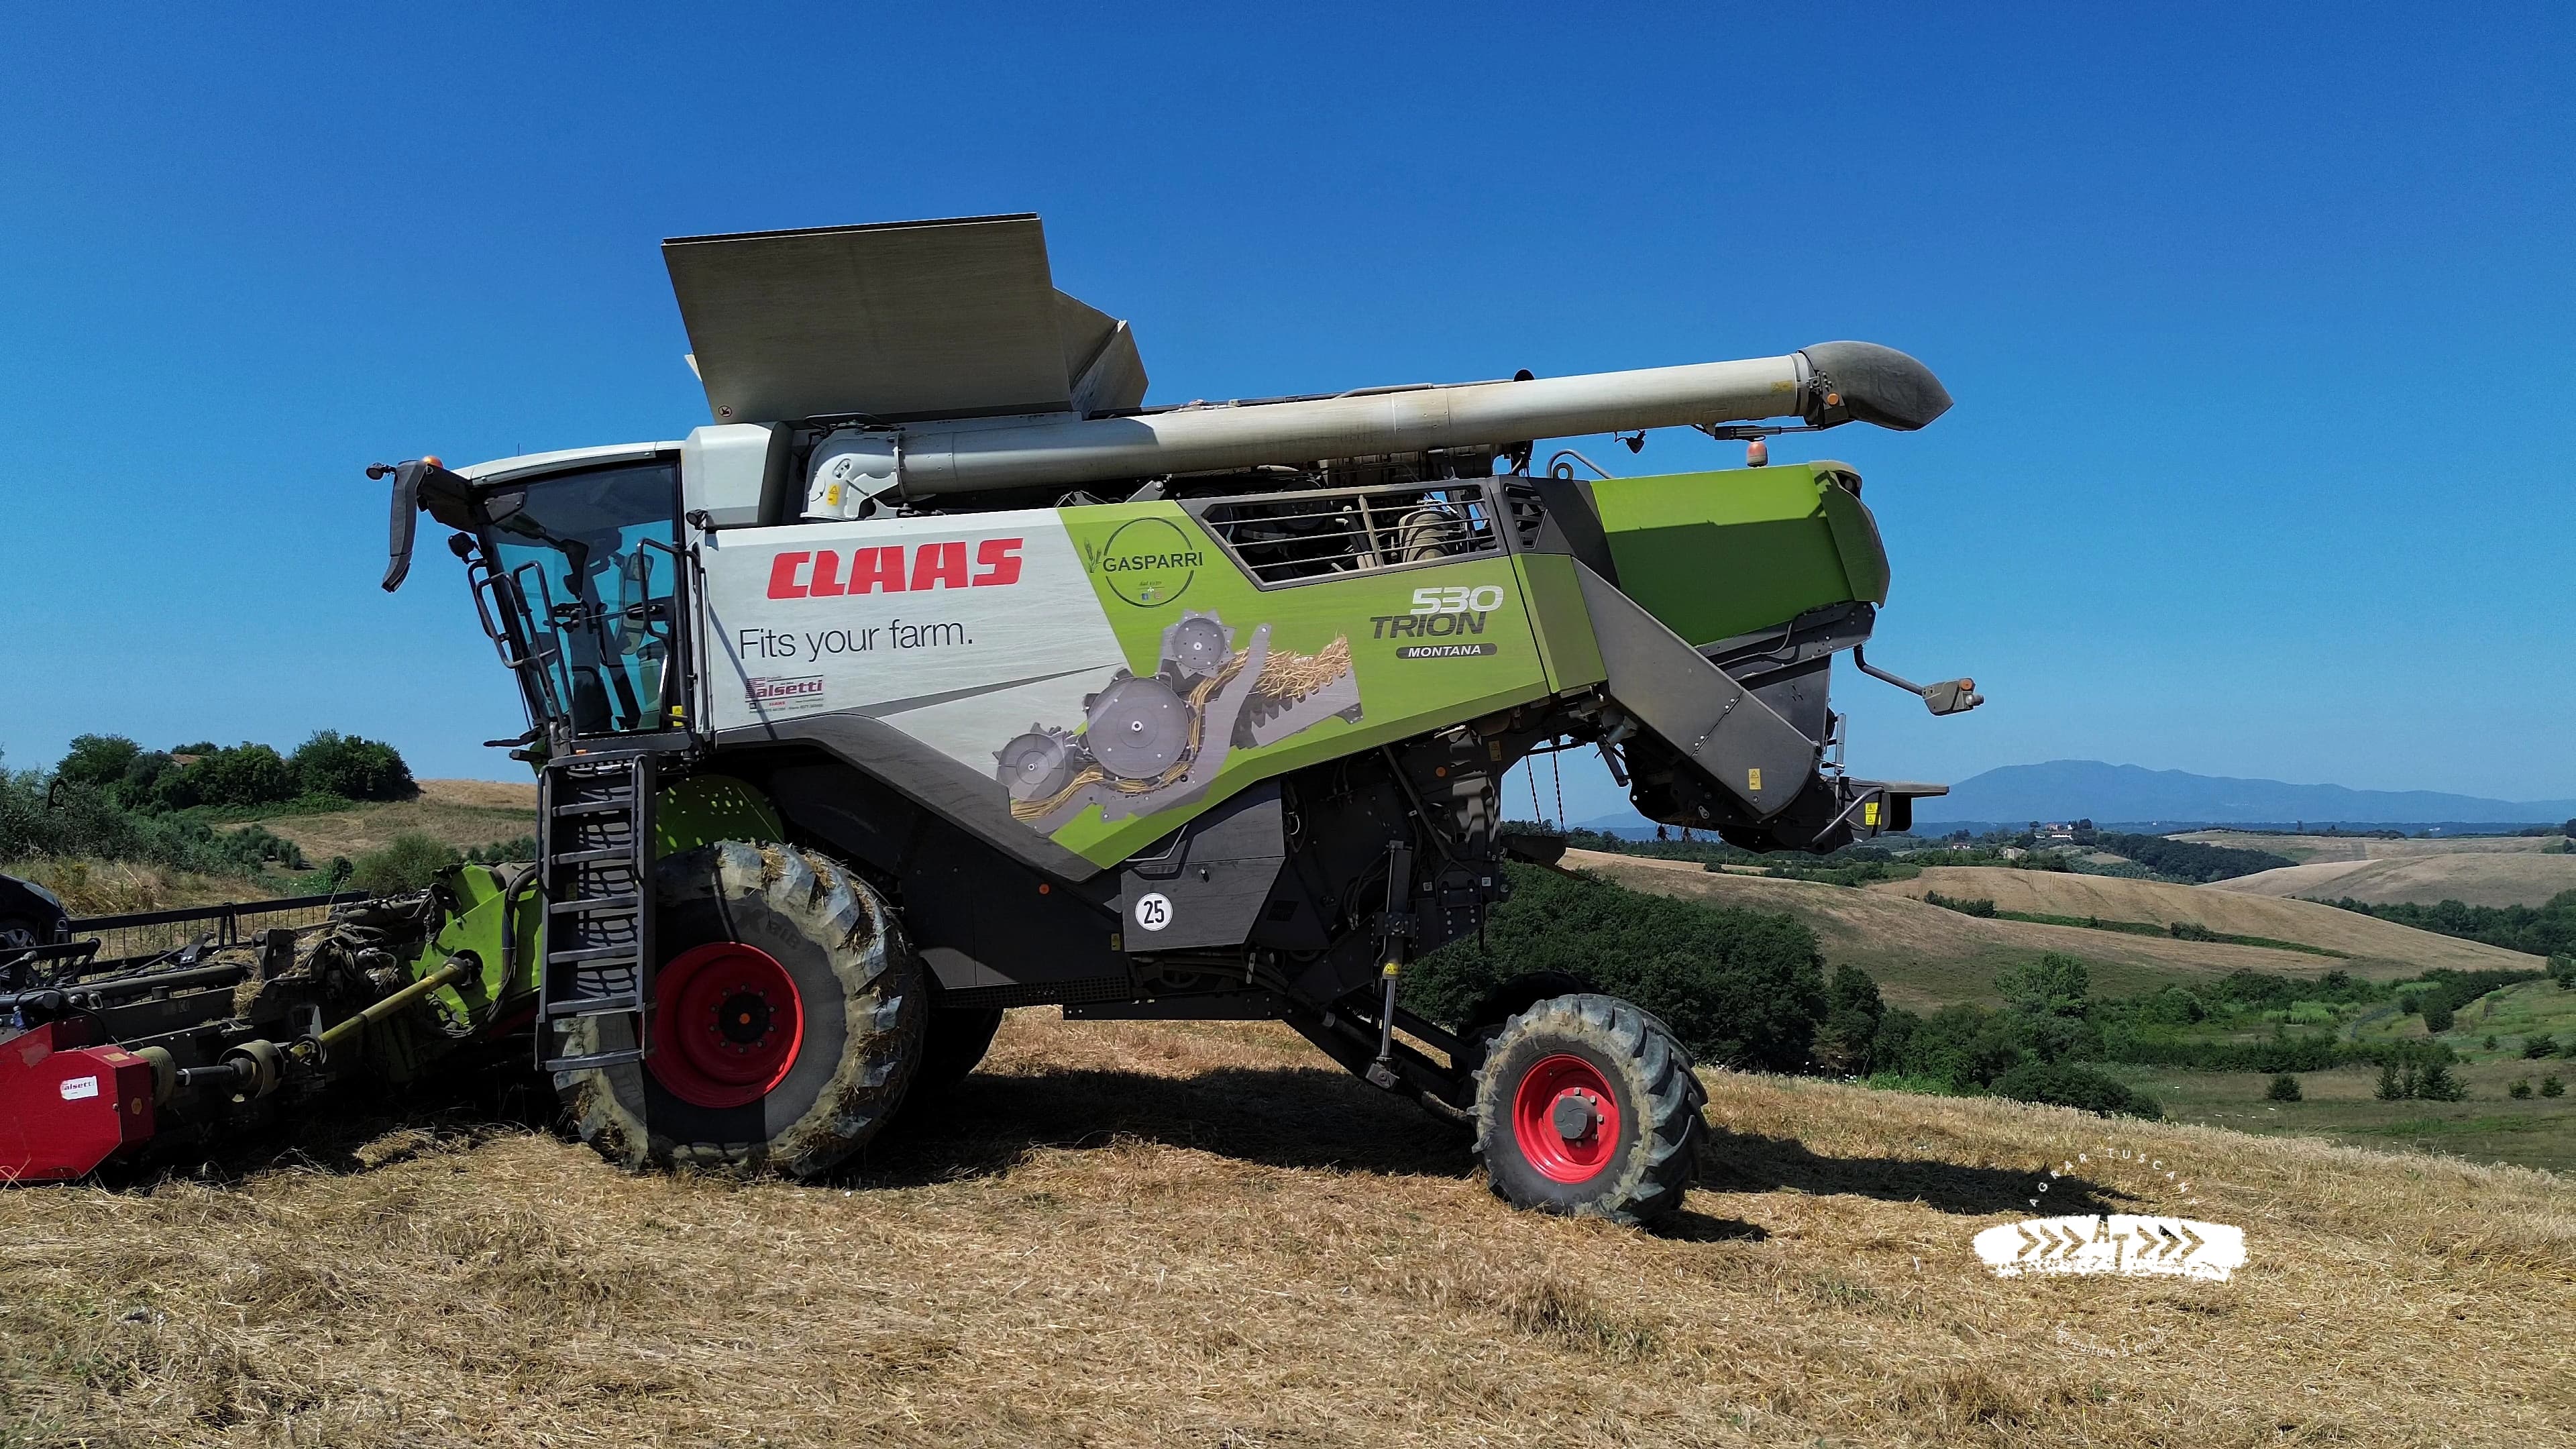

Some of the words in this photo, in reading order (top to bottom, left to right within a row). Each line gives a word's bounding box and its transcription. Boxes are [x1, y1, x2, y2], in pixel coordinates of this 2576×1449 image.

[767, 537, 1024, 599] CLAAS
[1103, 551, 1203, 572] GASPARRI
[1410, 585, 1504, 614] 530
[1369, 611, 1487, 639] TRION
[739, 627, 796, 659] Fits
[806, 627, 880, 663] your
[889, 619, 973, 649] farm.
[1407, 645, 1482, 658] MONTANA
[1143, 900, 1165, 924] 25
